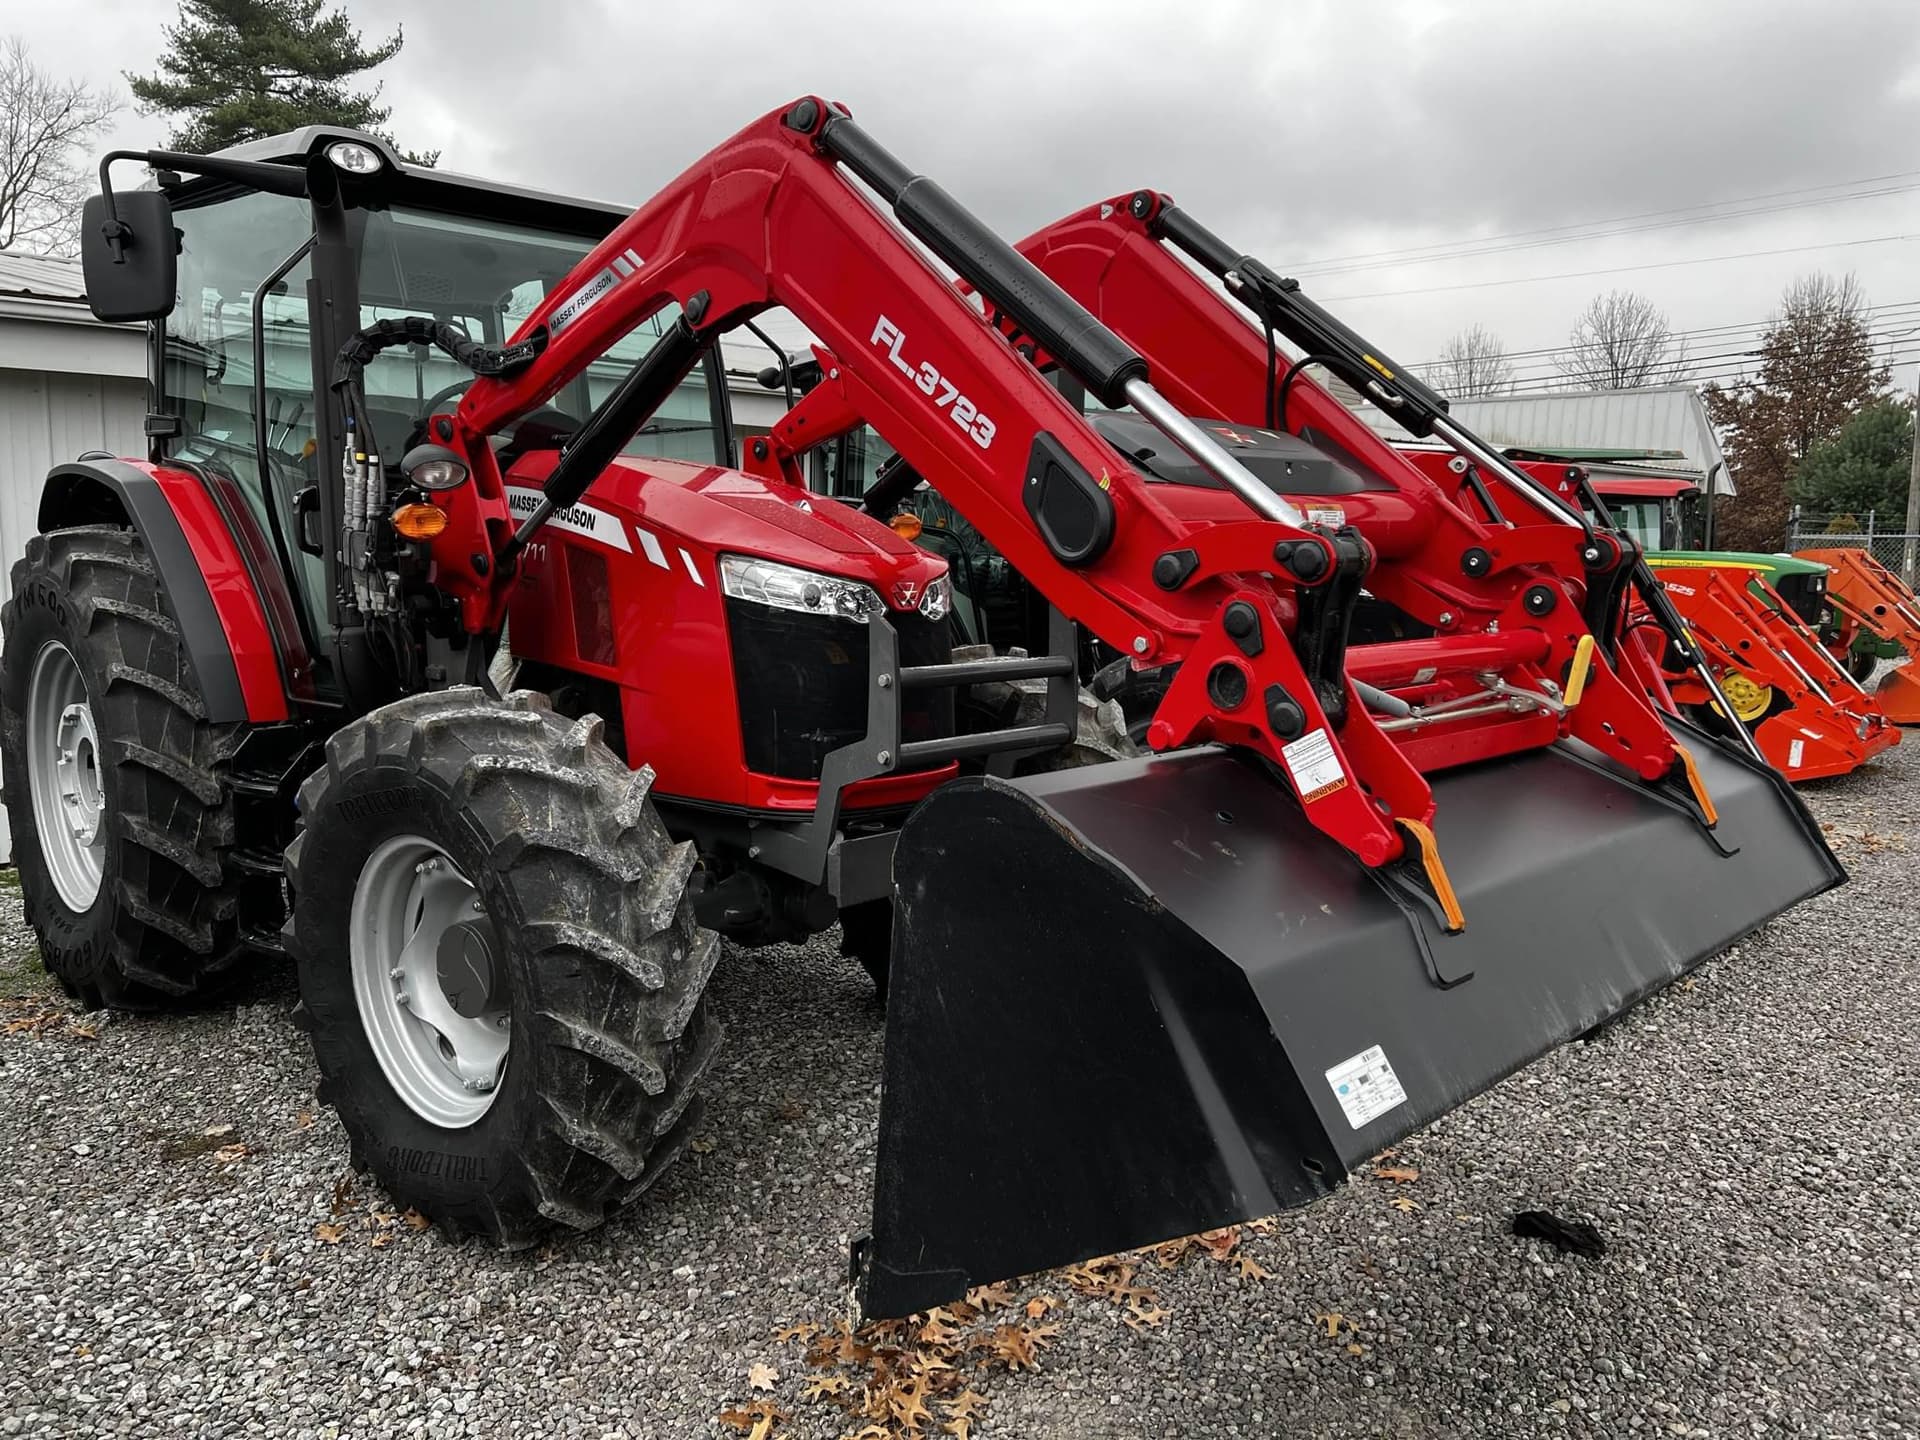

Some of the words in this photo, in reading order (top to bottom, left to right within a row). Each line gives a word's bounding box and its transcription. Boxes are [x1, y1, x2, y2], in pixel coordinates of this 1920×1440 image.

[550, 303, 577, 332] MASSEY
[576, 274, 613, 309] FERGUSON
[509, 494, 543, 513] MASSEY
[552, 505, 596, 531] RGUSON
[386, 1145, 489, 1182] TRELLEBORG
